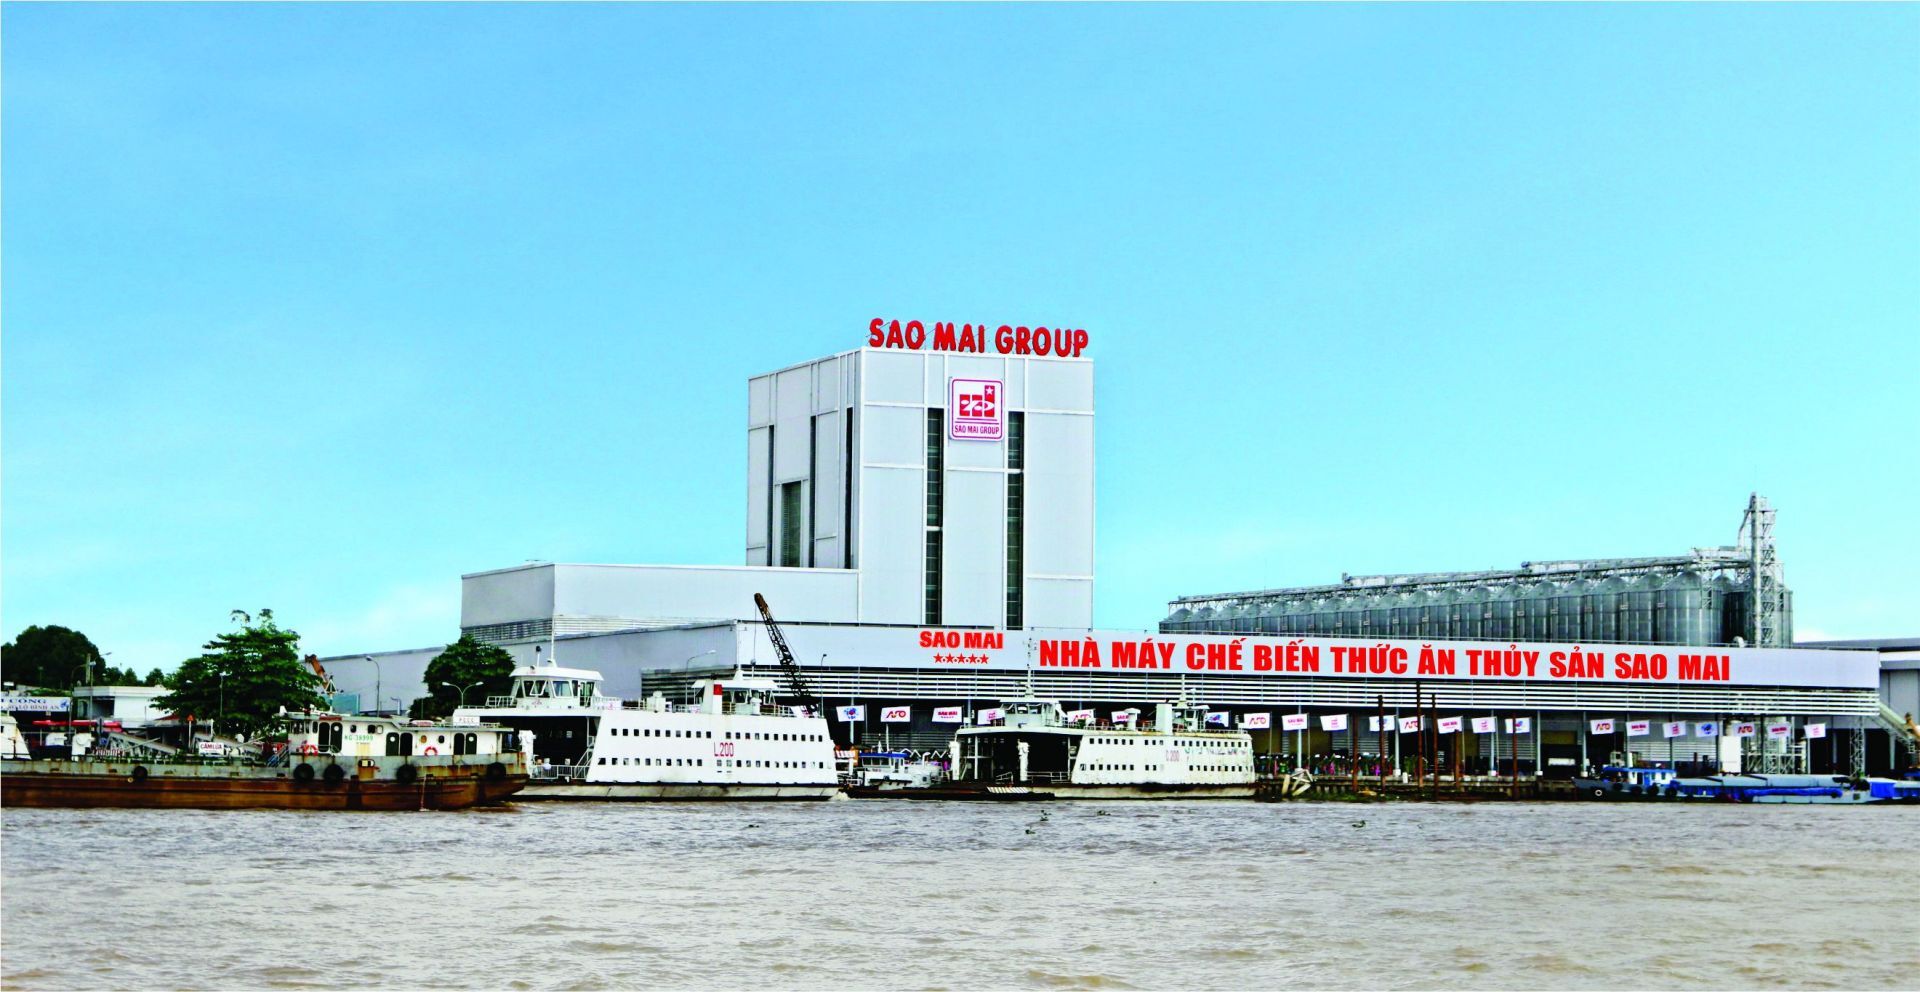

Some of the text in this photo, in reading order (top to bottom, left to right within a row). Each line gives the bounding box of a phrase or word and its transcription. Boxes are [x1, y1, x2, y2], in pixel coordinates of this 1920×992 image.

[869, 318, 1089, 358] SAO MAI GROUP
[954, 424, 1000, 435] SAO MAI GROUP
[918, 630, 1004, 650] SAO MAI
[1039, 637, 1731, 682] NHÀ MÁY CHẾ BIẾN THỨC ĂN THỦY SẢN SAO MAI
